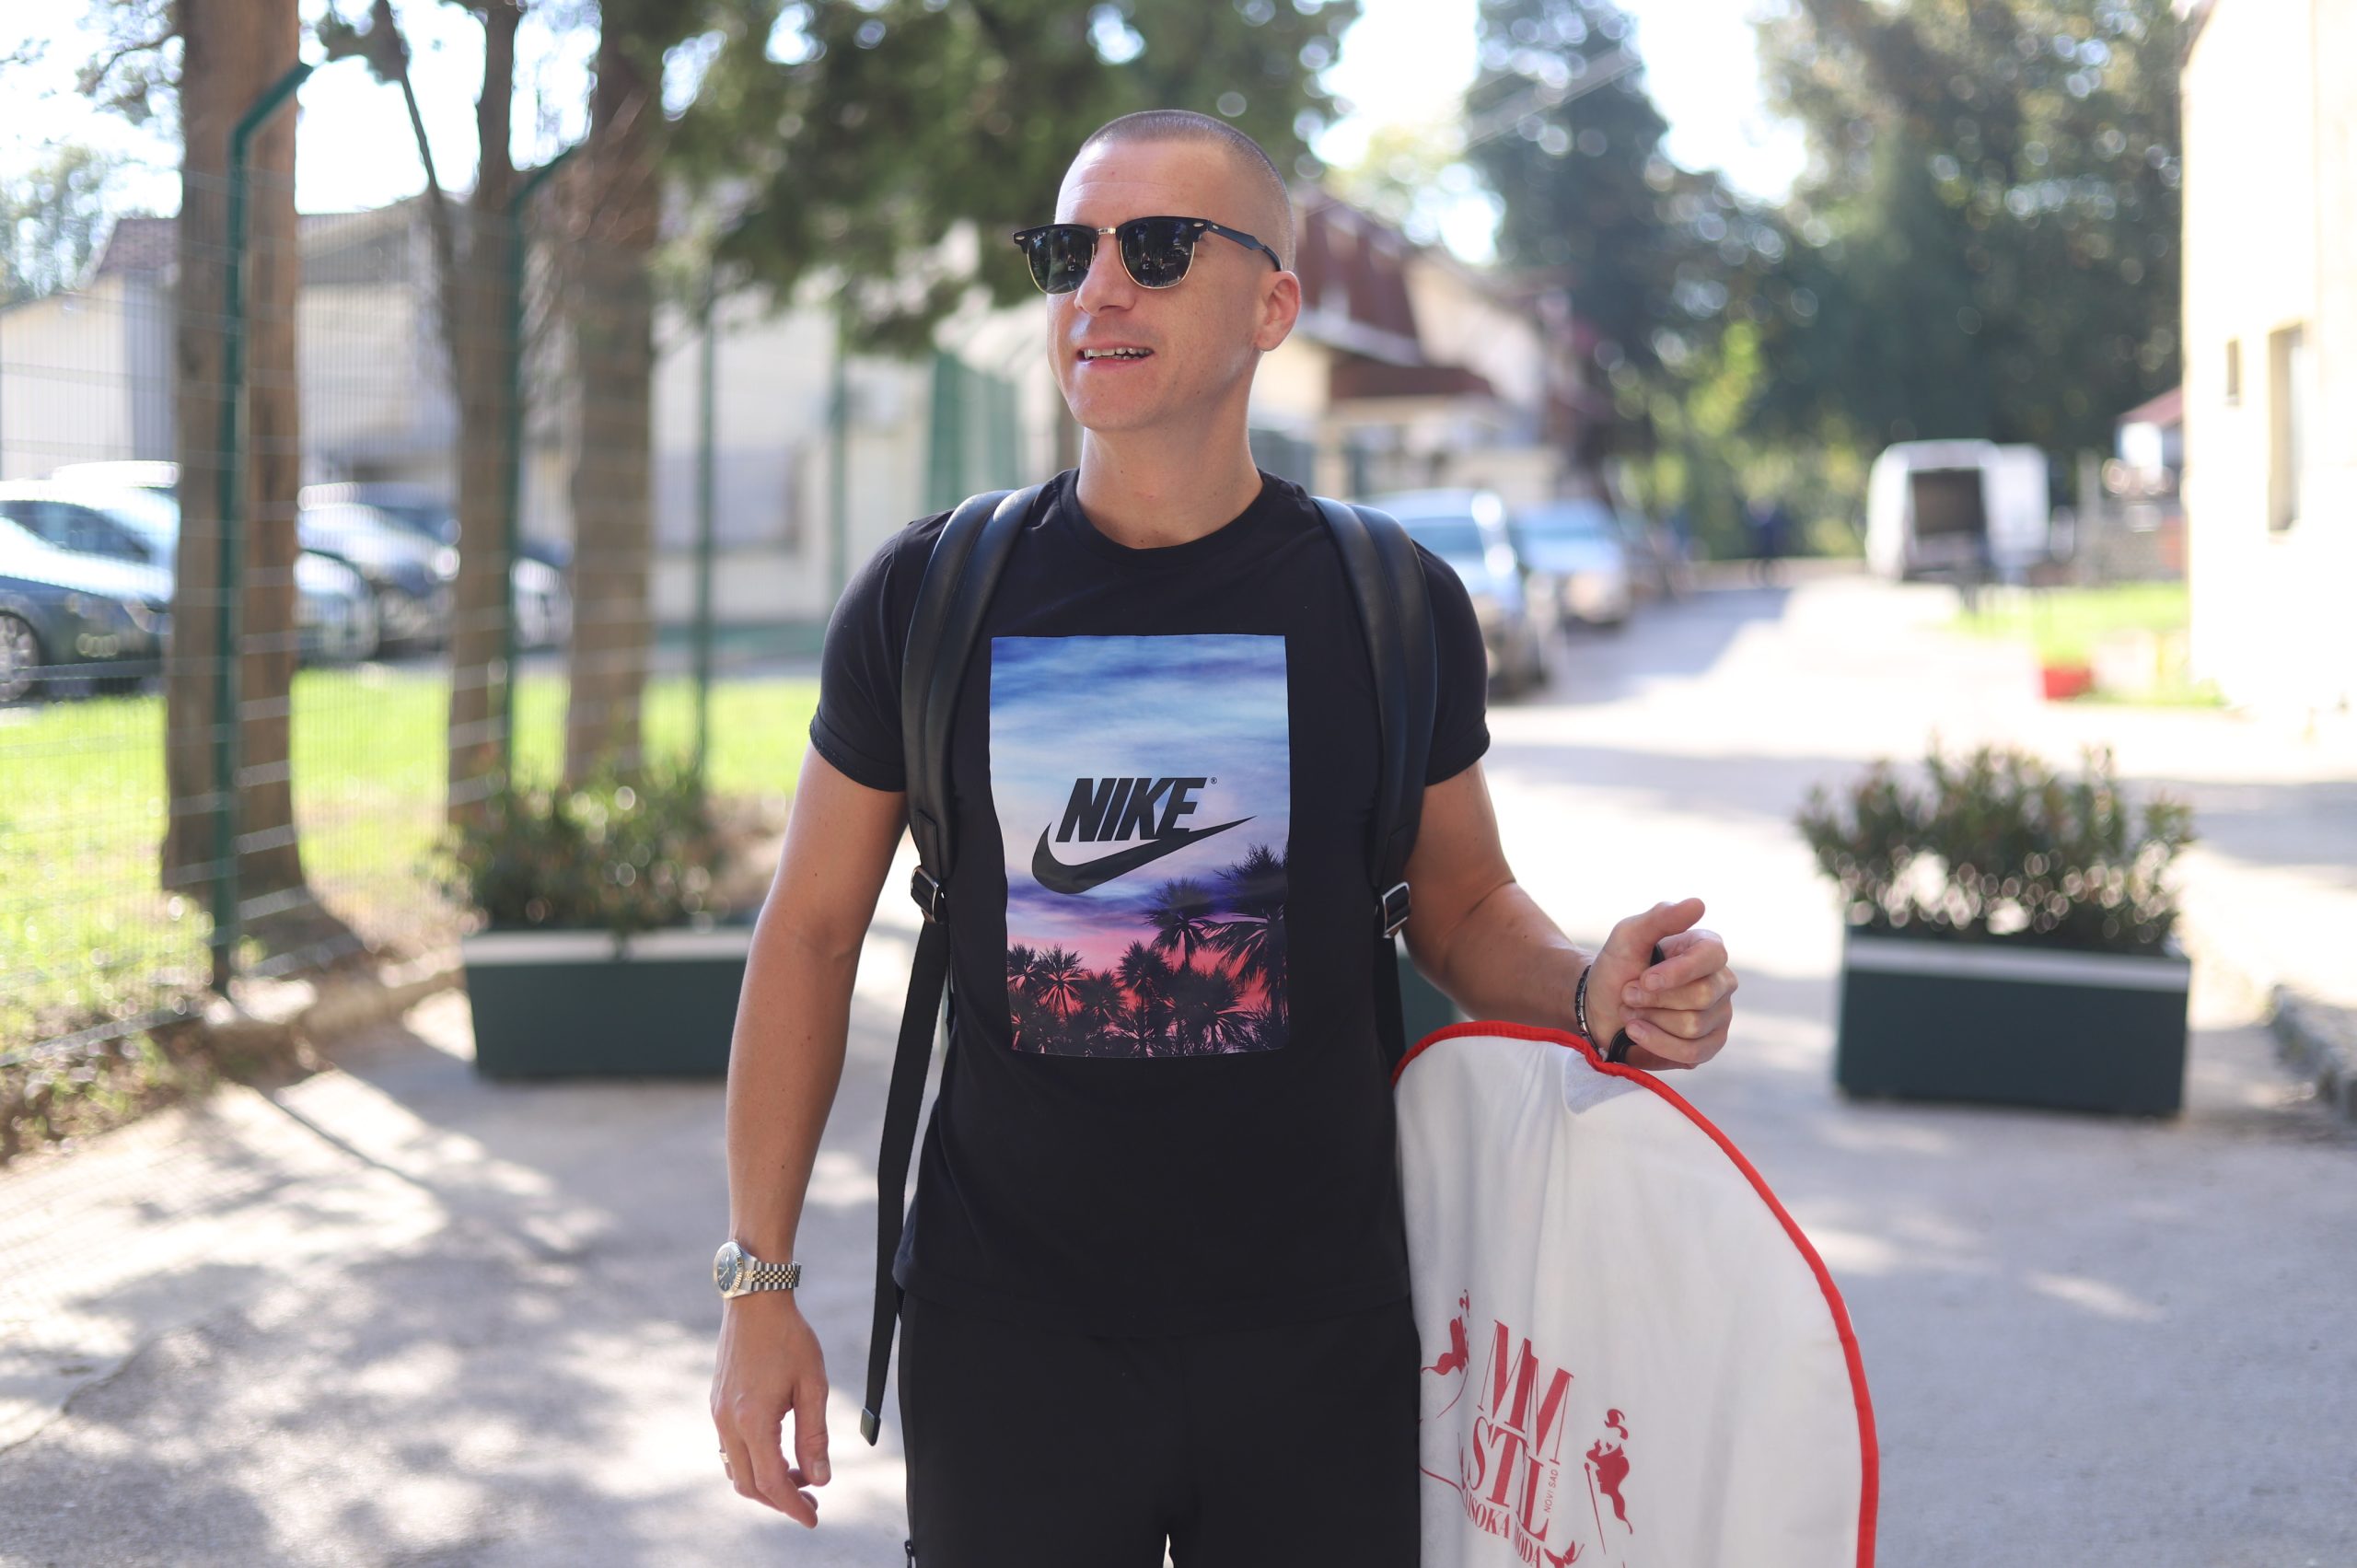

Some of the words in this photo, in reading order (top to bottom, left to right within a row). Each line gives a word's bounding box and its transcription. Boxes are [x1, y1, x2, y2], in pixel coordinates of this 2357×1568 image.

[1055, 777, 1207, 842] NIKE
[1468, 1416, 1549, 1542] STL
[1544, 1490, 1554, 1513] NOVI
[1549, 1469, 1559, 1488] SAD
